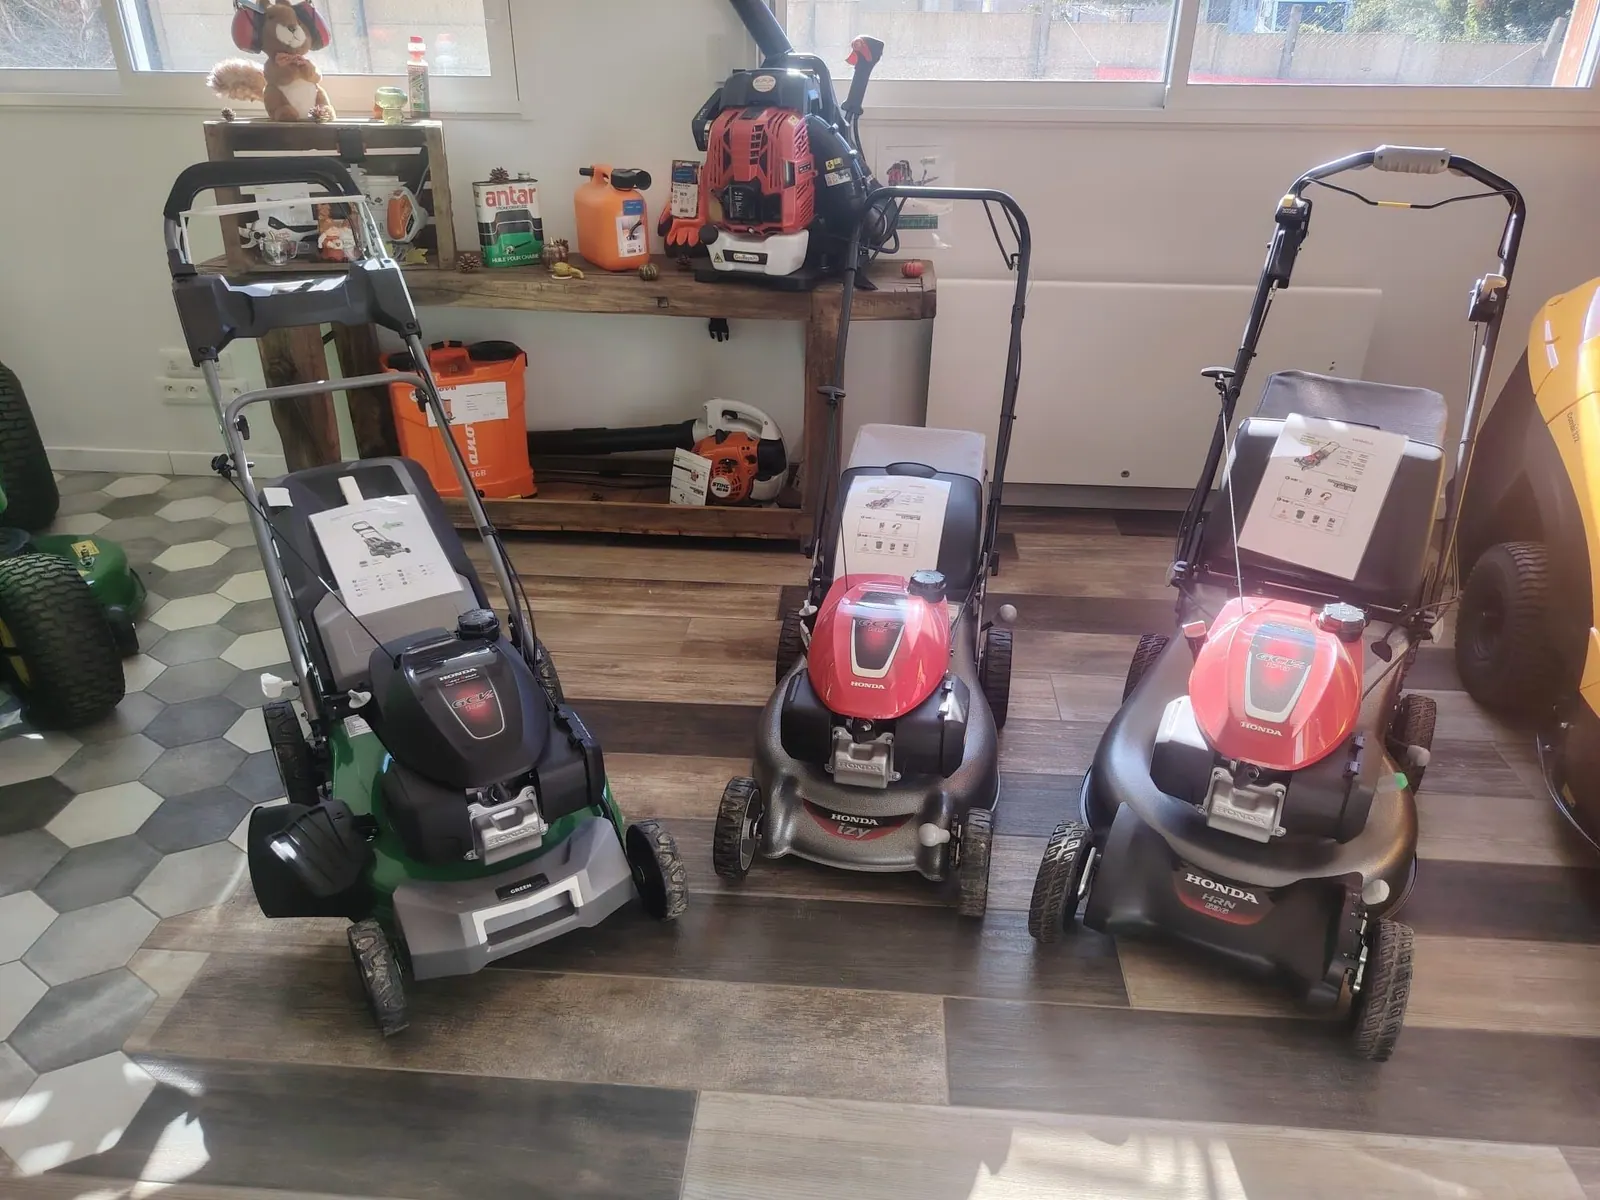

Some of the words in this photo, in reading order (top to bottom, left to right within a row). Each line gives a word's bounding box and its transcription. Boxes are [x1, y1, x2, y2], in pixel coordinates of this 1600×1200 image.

[485, 186, 537, 208] antar
[439, 668, 477, 681] HONDA
[850, 681, 886, 690] HONDA
[1240, 721, 1283, 737] HONDA
[838, 761, 883, 773] HONDA
[831, 813, 879, 826] HONDA
[1214, 805, 1265, 826] HONDA
[510, 883, 532, 894] GREEN
[1184, 872, 1260, 905] HONDA
[1202, 893, 1237, 910] HRN
